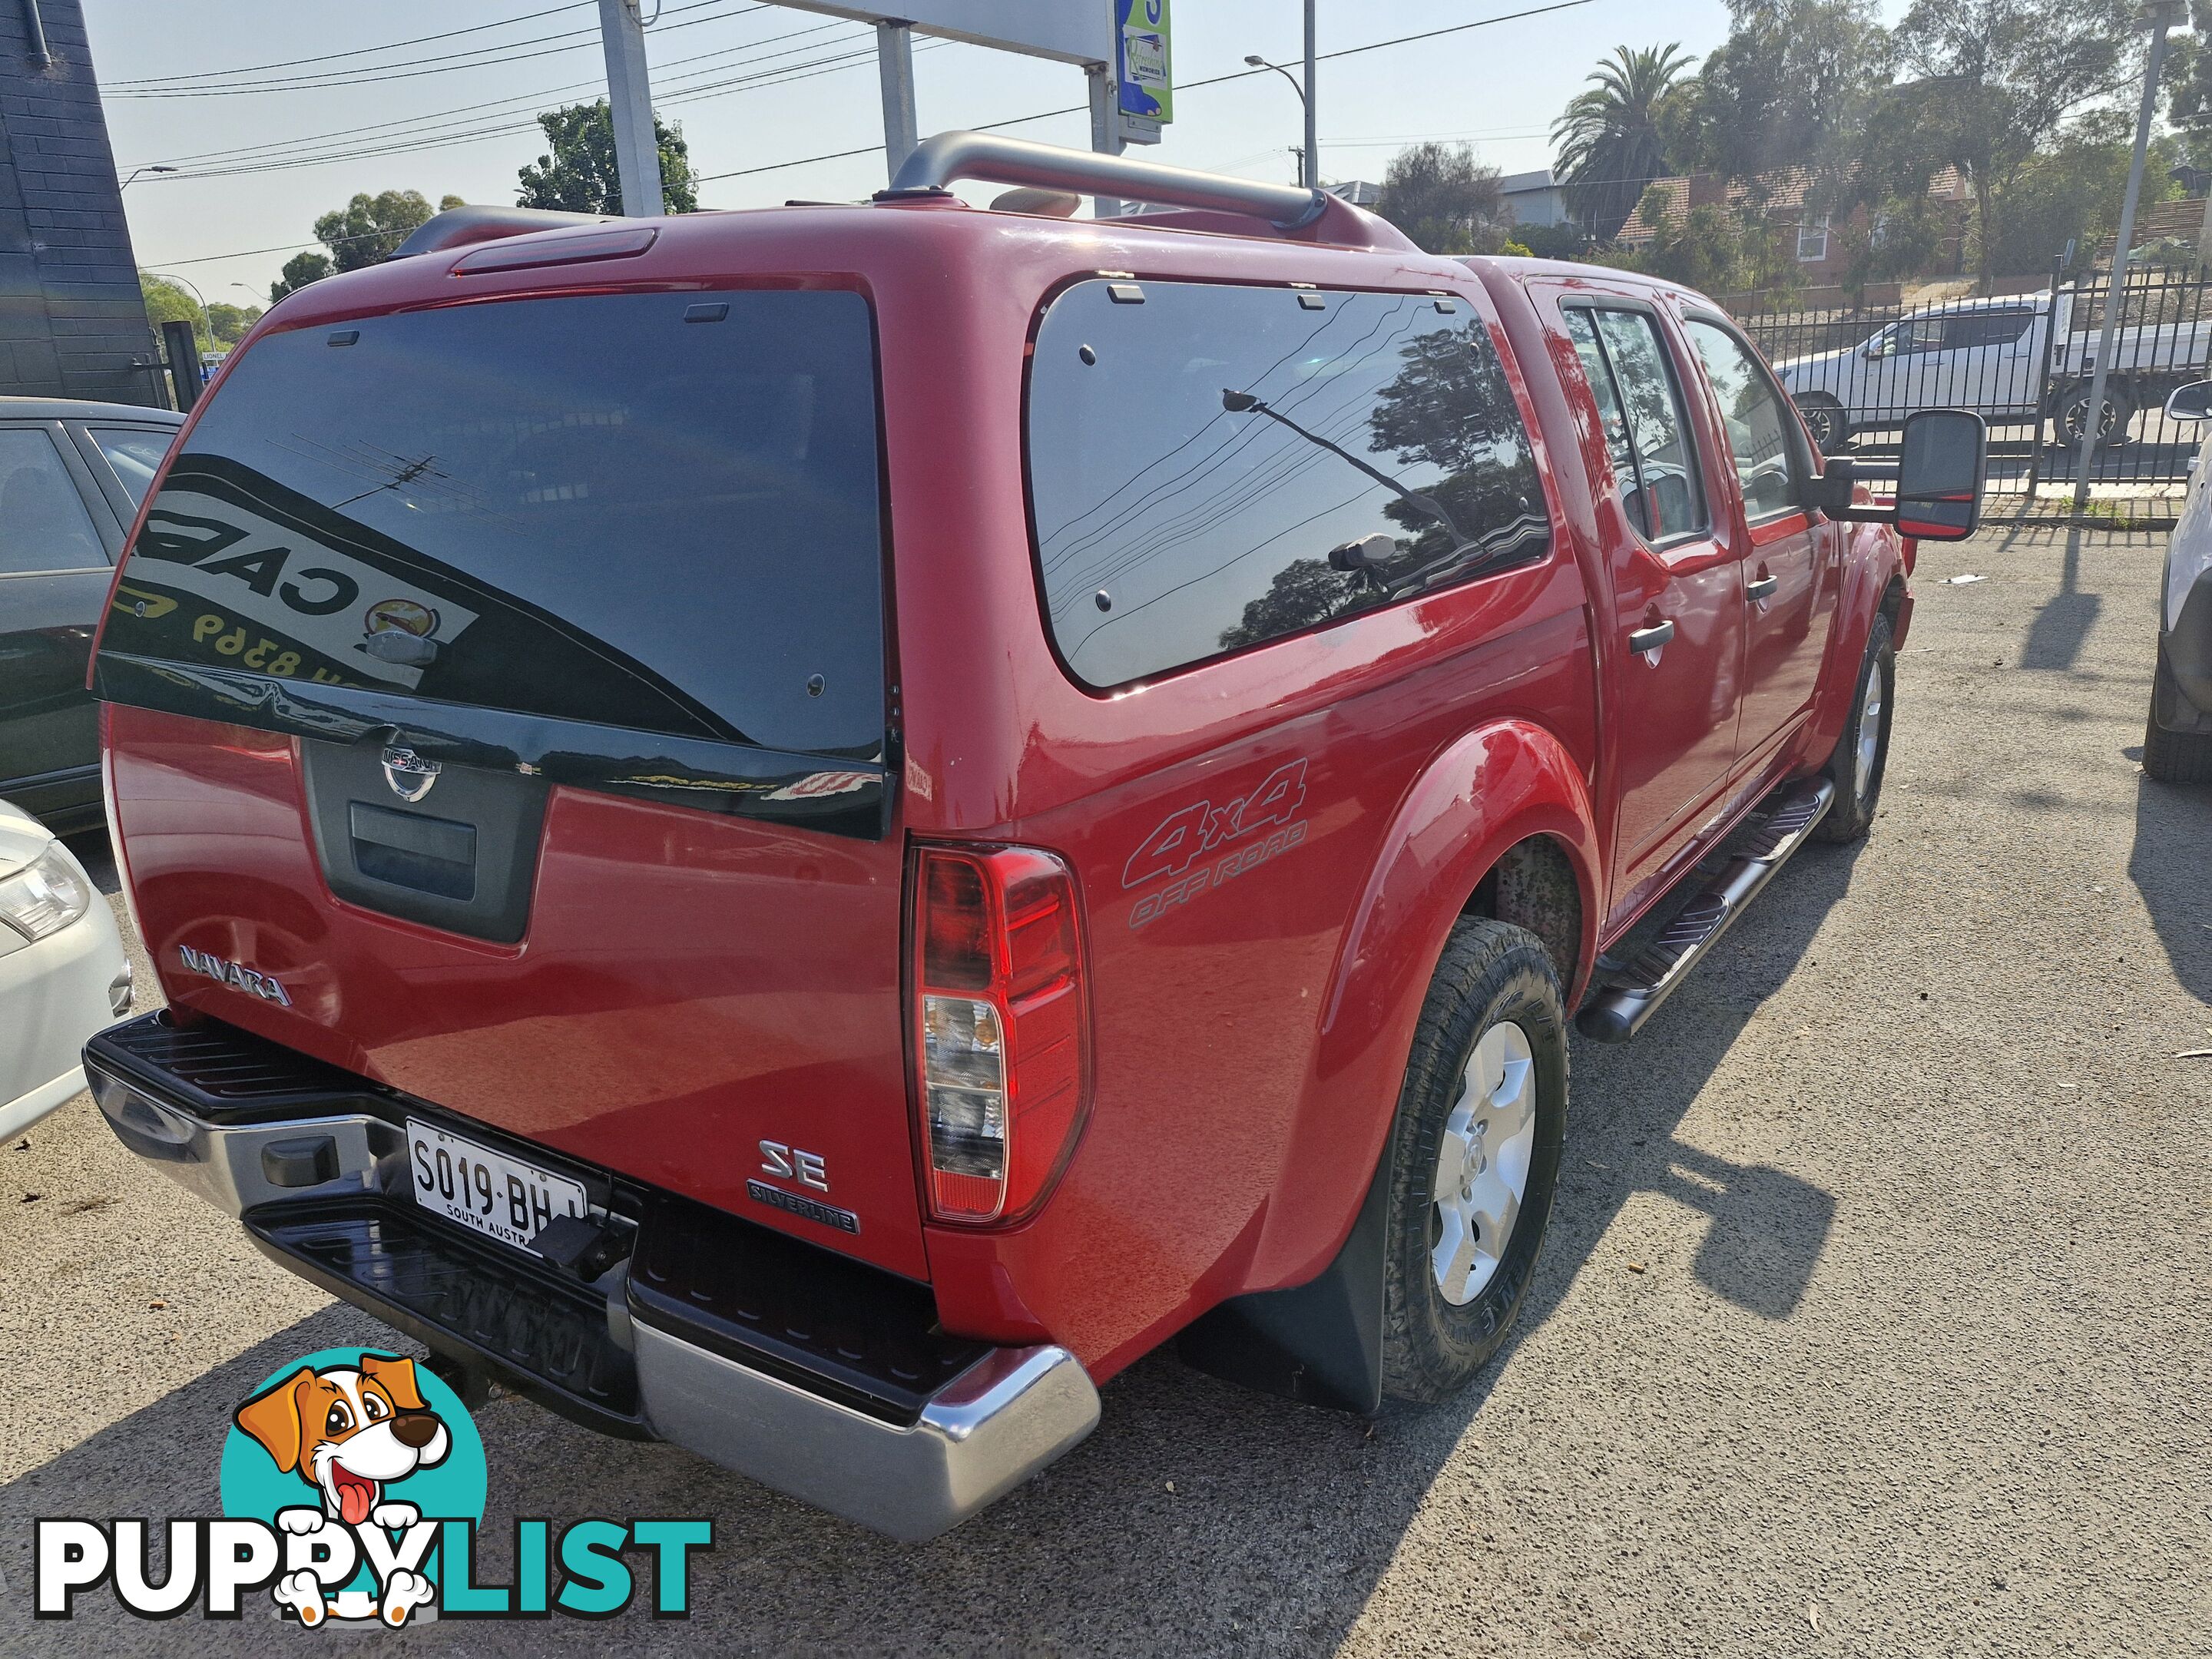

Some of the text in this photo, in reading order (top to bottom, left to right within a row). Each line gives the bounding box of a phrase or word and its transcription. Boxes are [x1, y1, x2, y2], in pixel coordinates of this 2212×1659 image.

[1129, 820, 1308, 929] OFF ROAD
[179, 944, 293, 1007] NAVARA
[759, 1138, 830, 1193] SE
[446, 1203, 531, 1247] SOUTH AUSTR
[750, 1185, 853, 1230] SILVERLINE
